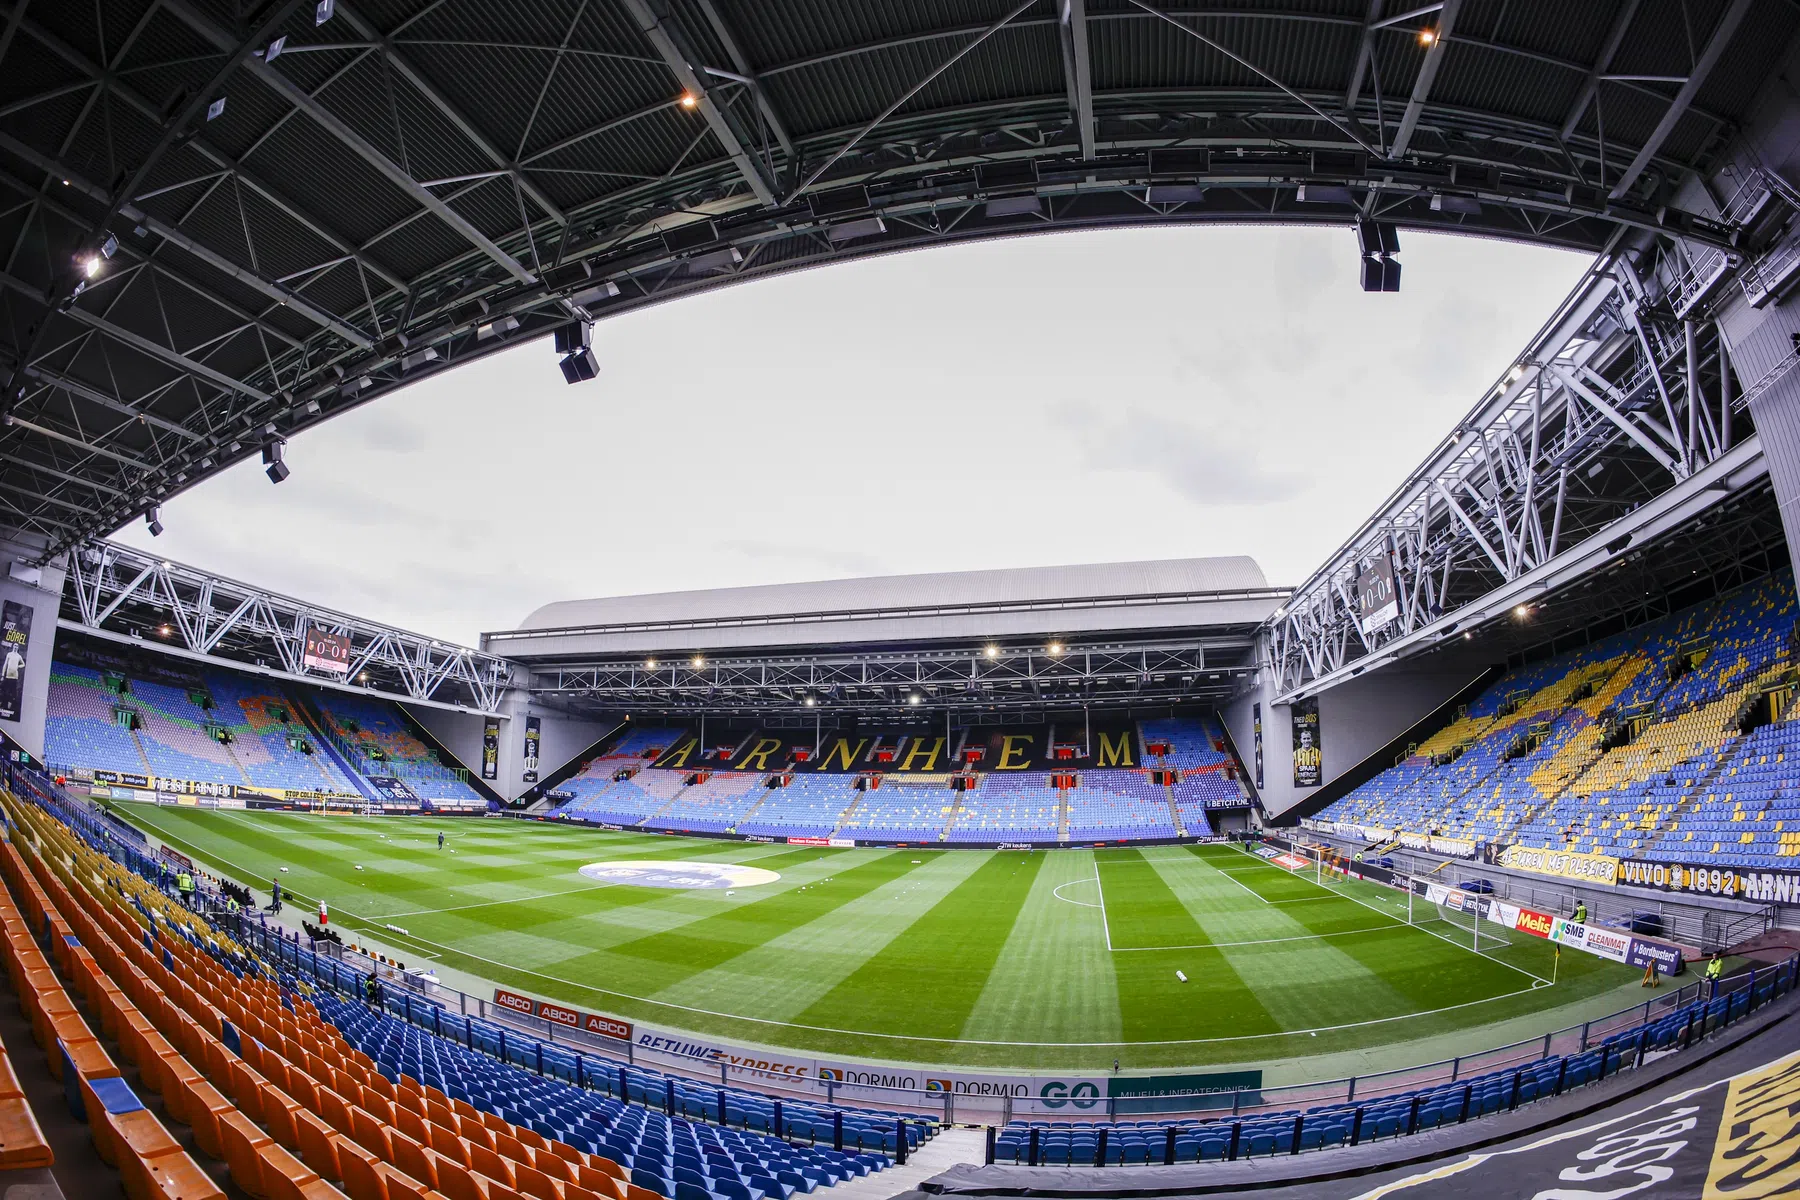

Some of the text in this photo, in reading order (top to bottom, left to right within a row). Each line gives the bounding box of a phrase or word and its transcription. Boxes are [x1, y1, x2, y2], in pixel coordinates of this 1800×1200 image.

[285, 790, 300, 798] STOP
[1547, 854, 1570, 873] MET
[1569, 857, 1615, 881] PLEZIER
[1623, 861, 1735, 896] VIVO 1892
[1517, 912, 1551, 934] Melis
[1565, 923, 1585, 939] SMB
[1587, 932, 1627, 951] CLEANMAT
[499, 993, 531, 1011] ABCO
[542, 1007, 577, 1024] ABCO
[589, 1018, 628, 1036] ABCO
[846, 1070, 916, 1090] DORMIO
[955, 1080, 1029, 1098] DORMIO
[1040, 1081, 1099, 1109] G4
